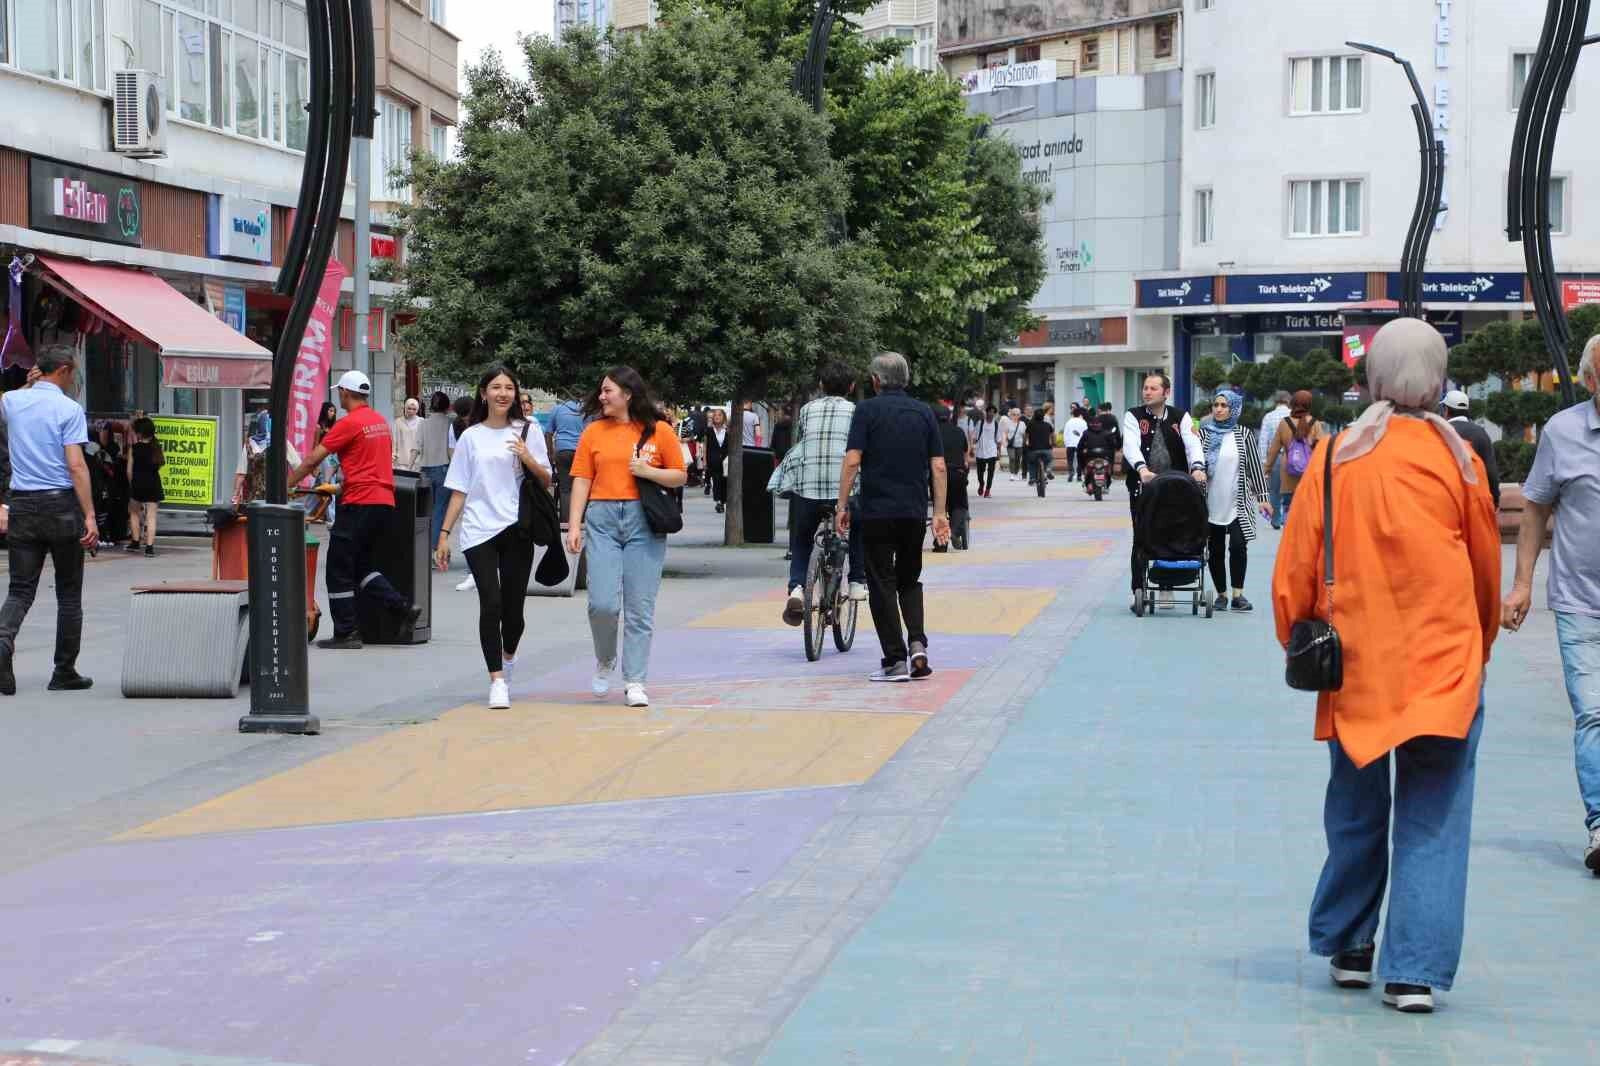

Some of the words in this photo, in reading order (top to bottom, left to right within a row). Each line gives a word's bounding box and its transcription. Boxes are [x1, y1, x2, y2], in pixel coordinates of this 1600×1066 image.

[990, 63, 1038, 86] PlayStation
[1258, 284, 1278, 294] Türk
[1280, 284, 1317, 294] Telekom
[1440, 282, 1478, 293] Telekom
[1285, 315, 1311, 328] Türk
